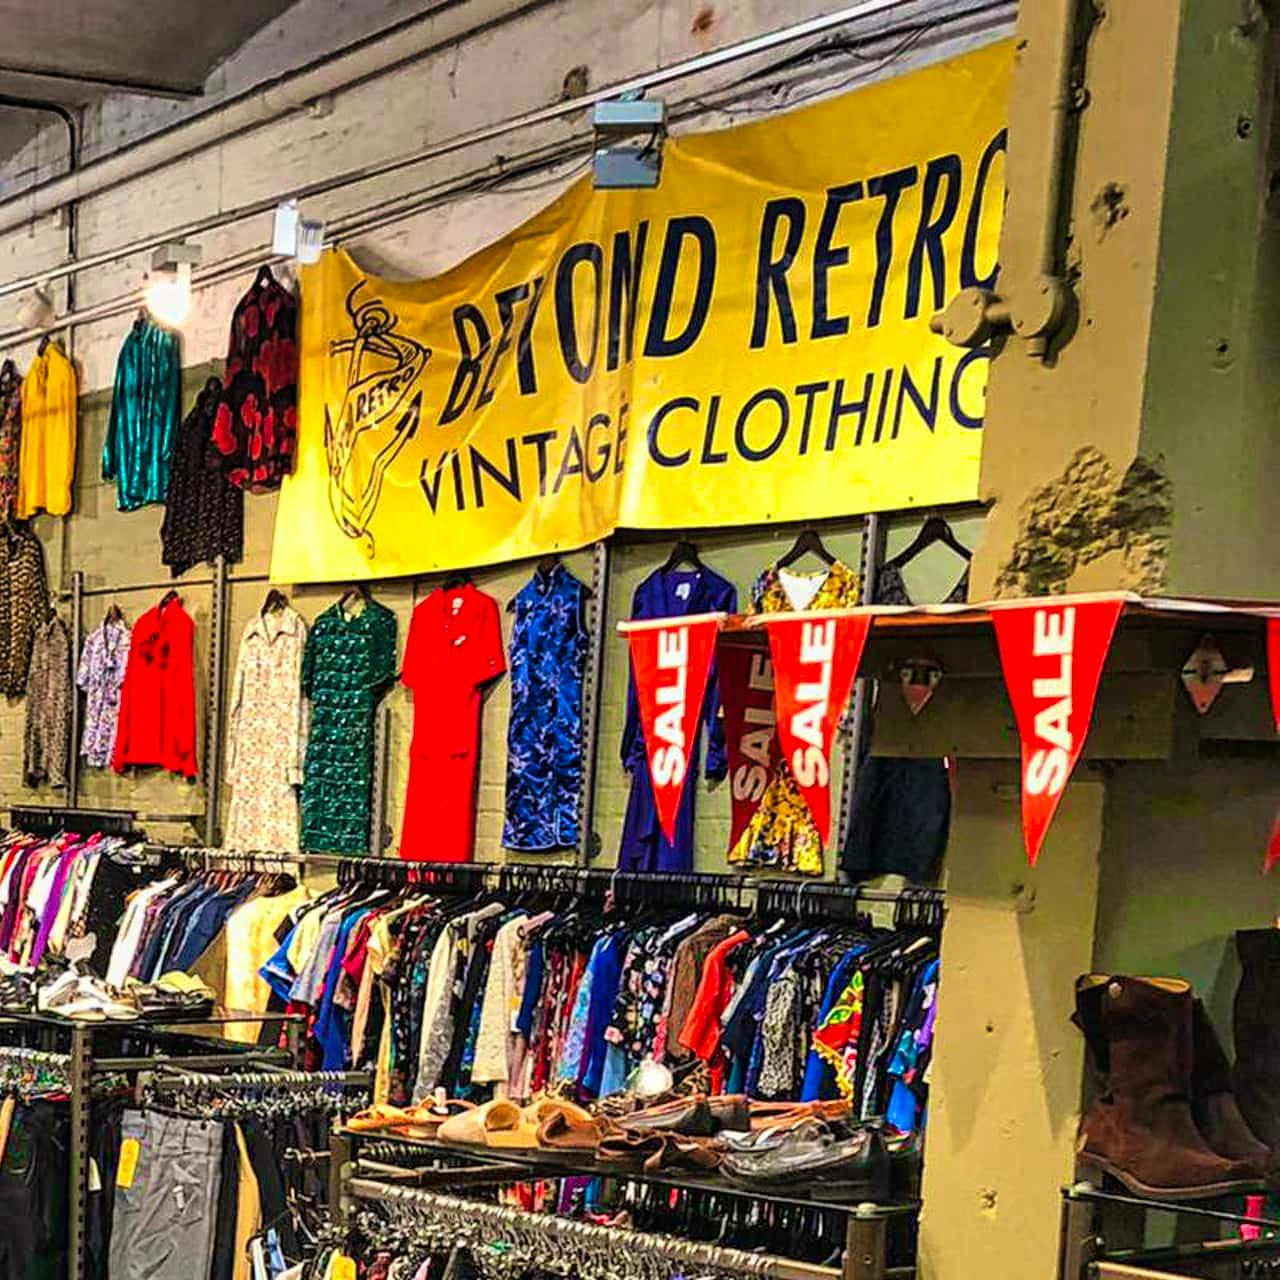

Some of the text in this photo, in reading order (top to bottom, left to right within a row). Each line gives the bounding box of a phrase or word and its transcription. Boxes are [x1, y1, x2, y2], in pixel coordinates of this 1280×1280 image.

[356, 366, 415, 423] RETRO
[438, 215, 718, 426] BEYOND
[419, 348, 993, 516] VINTAGE CLOTHING
[651, 625, 689, 788] SALE
[790, 619, 837, 789] SALE
[1024, 606, 1076, 796] SALE
